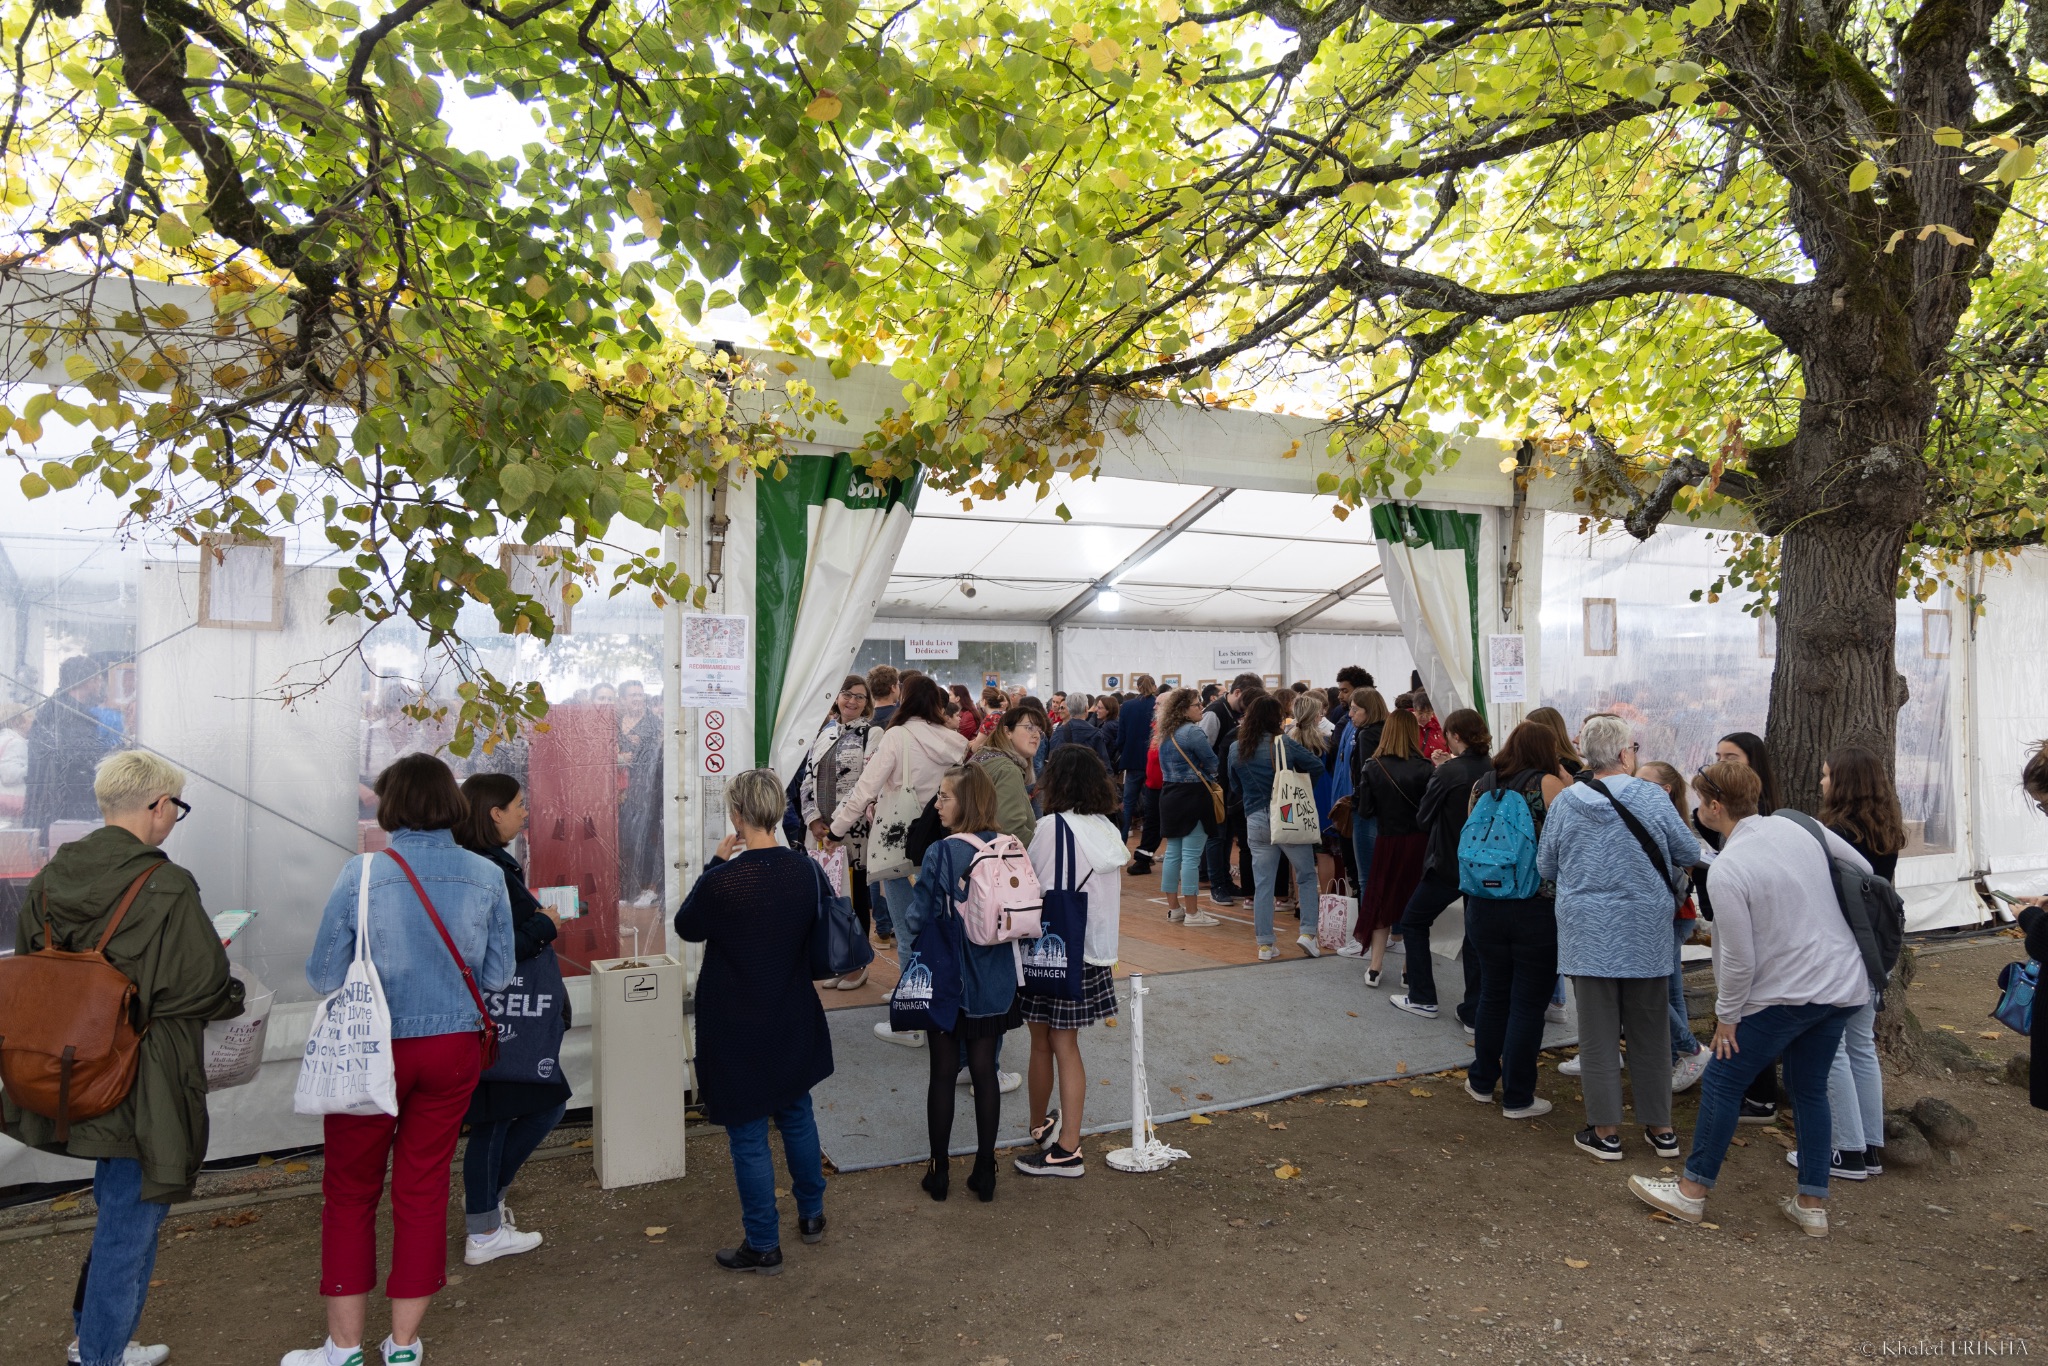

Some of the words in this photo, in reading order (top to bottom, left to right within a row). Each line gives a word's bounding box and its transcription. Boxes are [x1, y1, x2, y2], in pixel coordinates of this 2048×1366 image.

[1230, 649, 1254, 657] Sciences
[1303, 817, 1318, 832] PAS
[1023, 967, 1066, 978] PENHAGEN
[483, 992, 552, 1017] SELF
[229, 1026, 258, 1035] LIVRE
[347, 1020, 371, 1040] qui
[363, 1044, 376, 1053] PAS
[342, 1073, 371, 1095] PAGE
